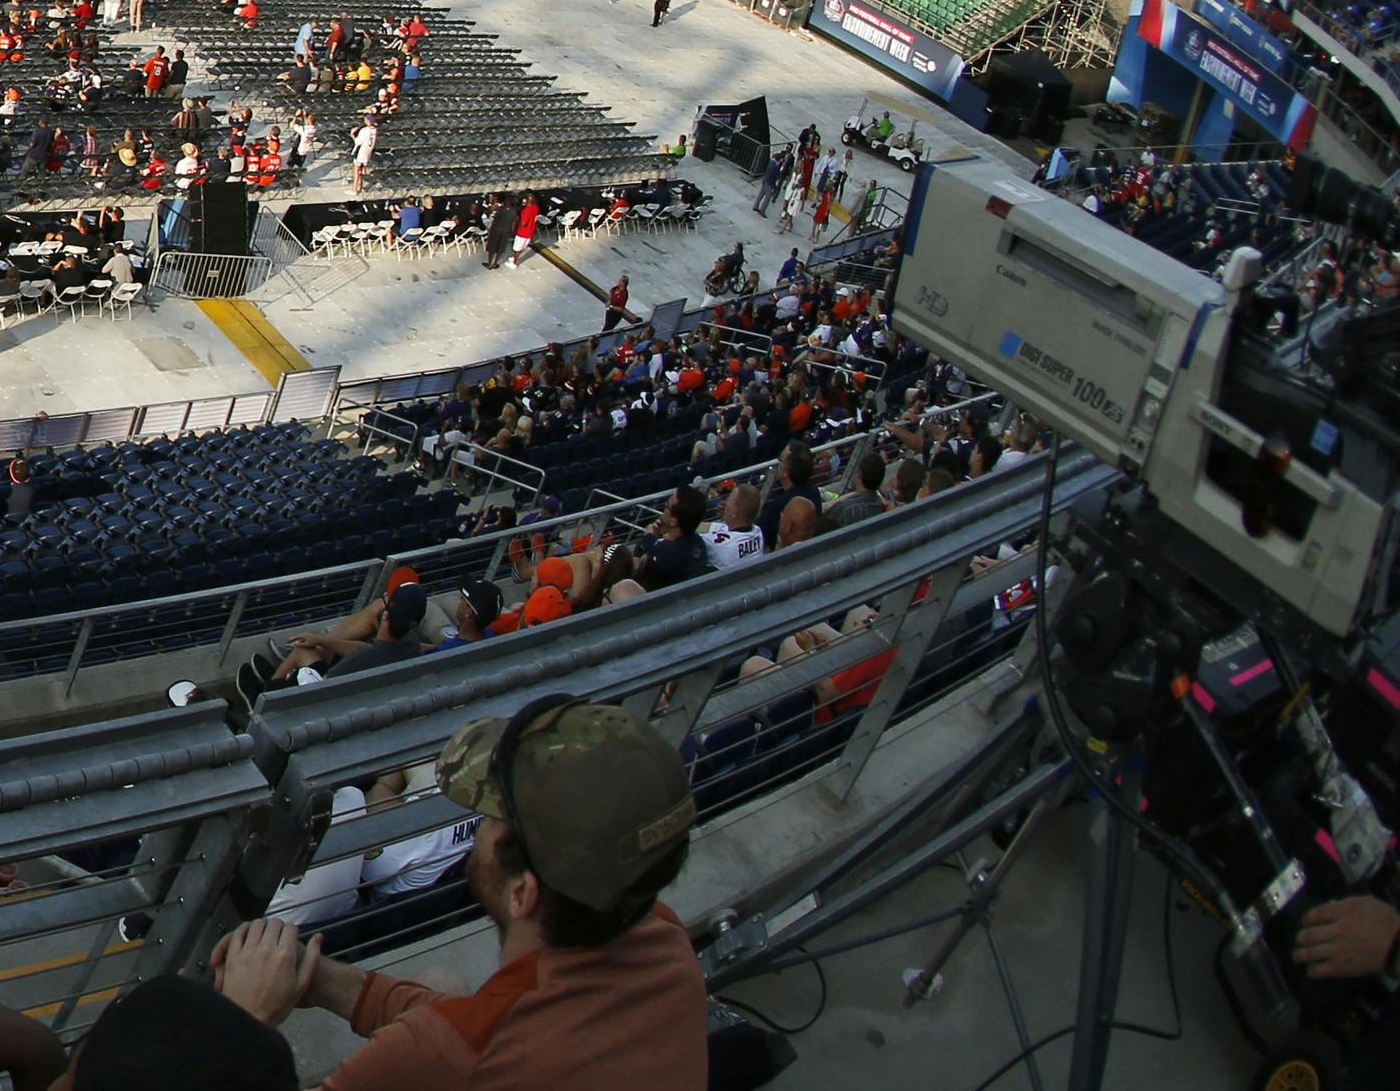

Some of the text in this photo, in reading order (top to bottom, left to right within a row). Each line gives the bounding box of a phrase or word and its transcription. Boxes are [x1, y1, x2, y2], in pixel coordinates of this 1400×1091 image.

[889, 37, 912, 63] WEEK
[996, 264, 1027, 287] Canon
[1019, 341, 1106, 409] DIGI SUPER 100
[737, 537, 762, 559] BAILEY
